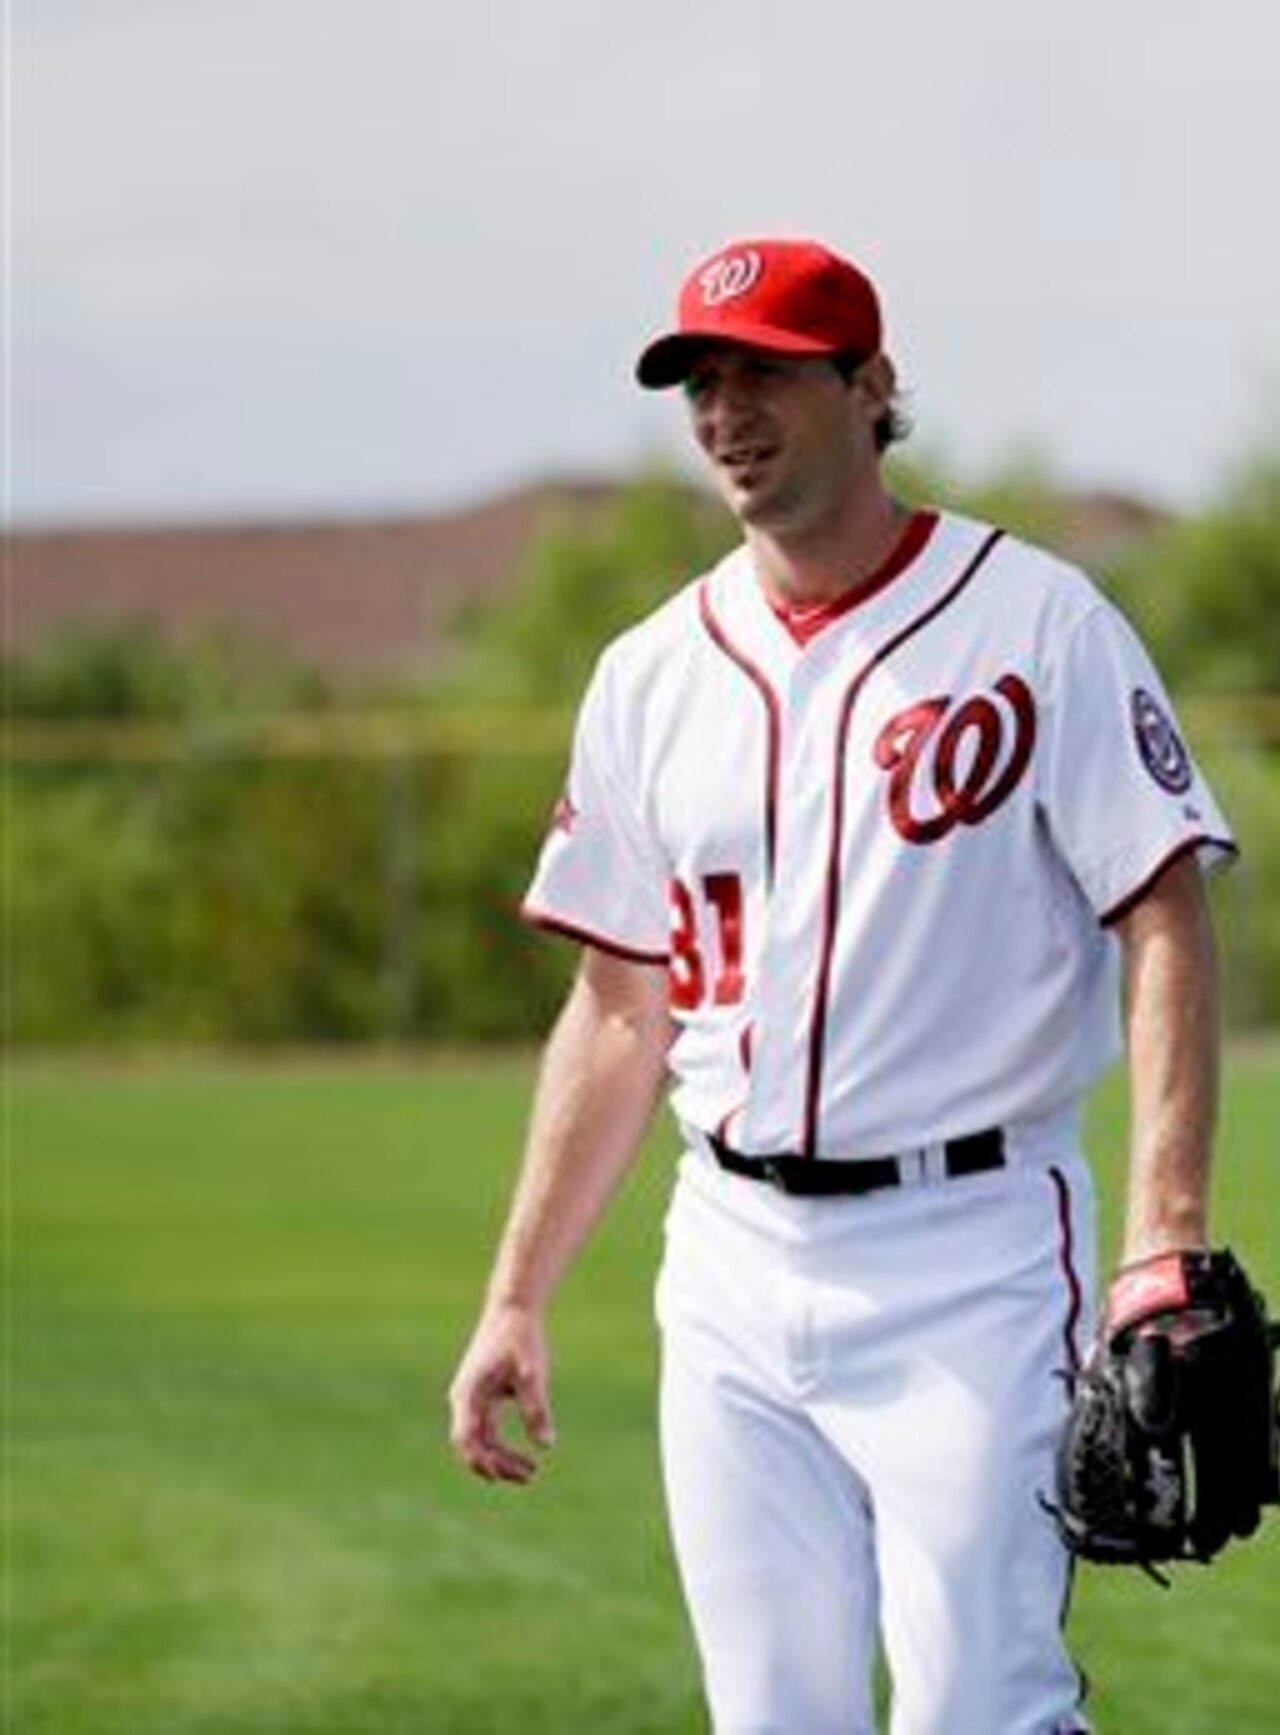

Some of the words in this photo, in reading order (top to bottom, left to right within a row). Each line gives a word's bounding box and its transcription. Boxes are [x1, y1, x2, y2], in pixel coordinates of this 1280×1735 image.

[699, 249, 761, 306] W
[873, 674, 1036, 845] W
[668, 872, 745, 1012] 31
